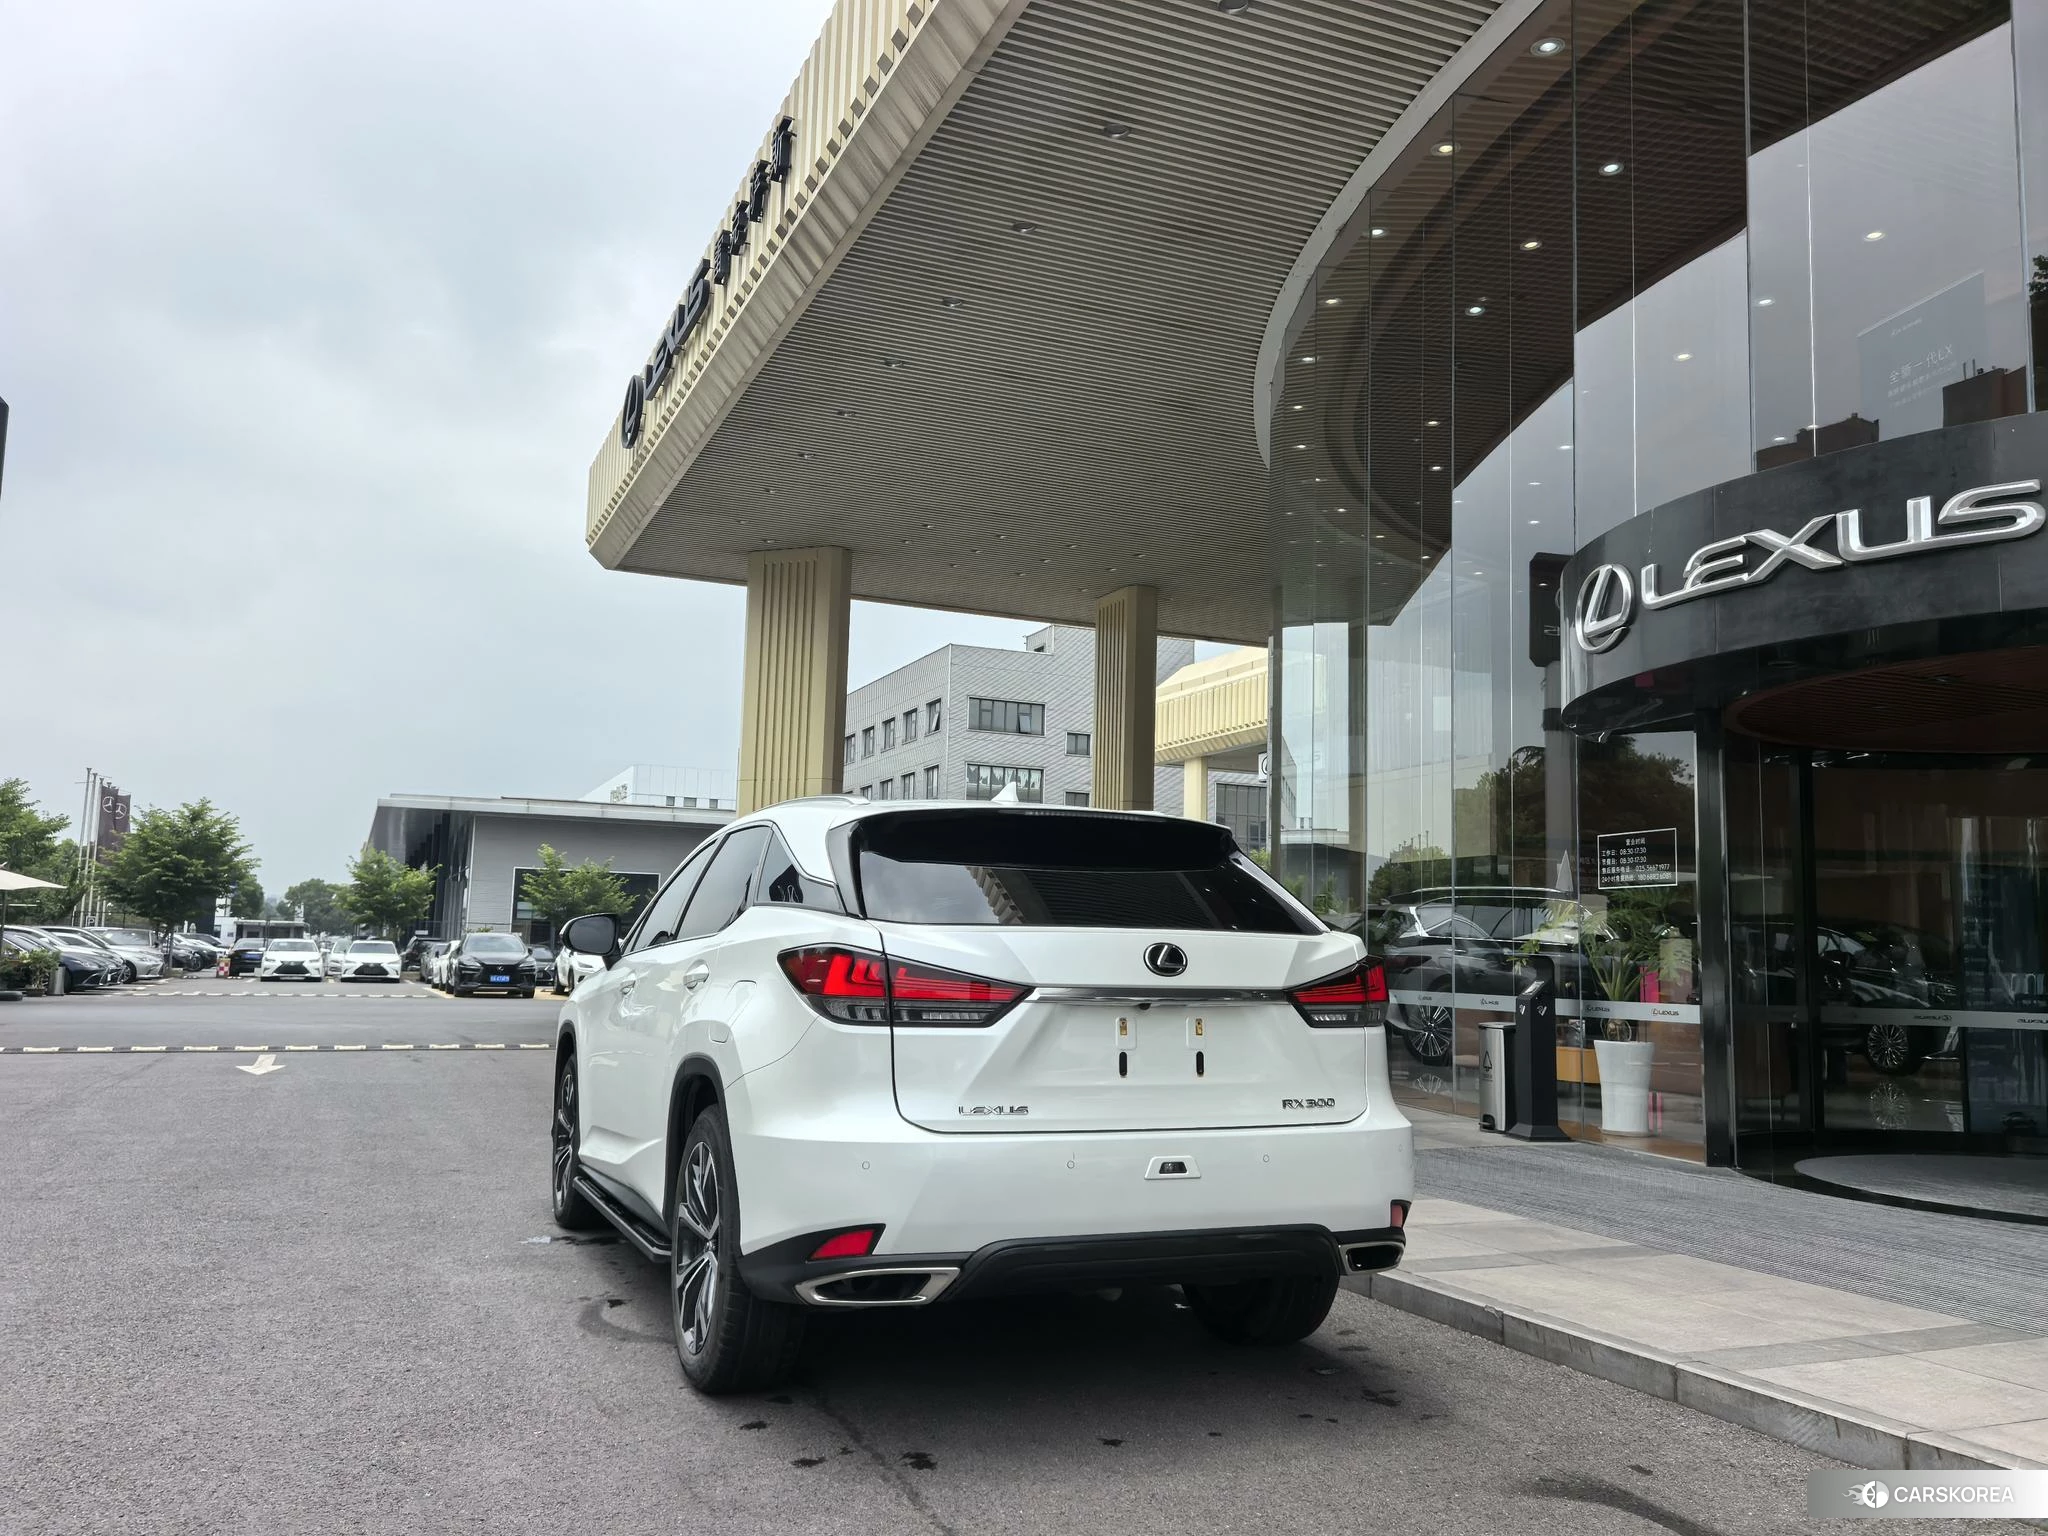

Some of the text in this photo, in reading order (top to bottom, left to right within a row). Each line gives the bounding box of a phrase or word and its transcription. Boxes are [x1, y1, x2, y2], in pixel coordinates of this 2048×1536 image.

[644, 258, 712, 401] LEXUS
[1640, 478, 2047, 611] LEXUS
[958, 1105, 1029, 1116] LEXUS
